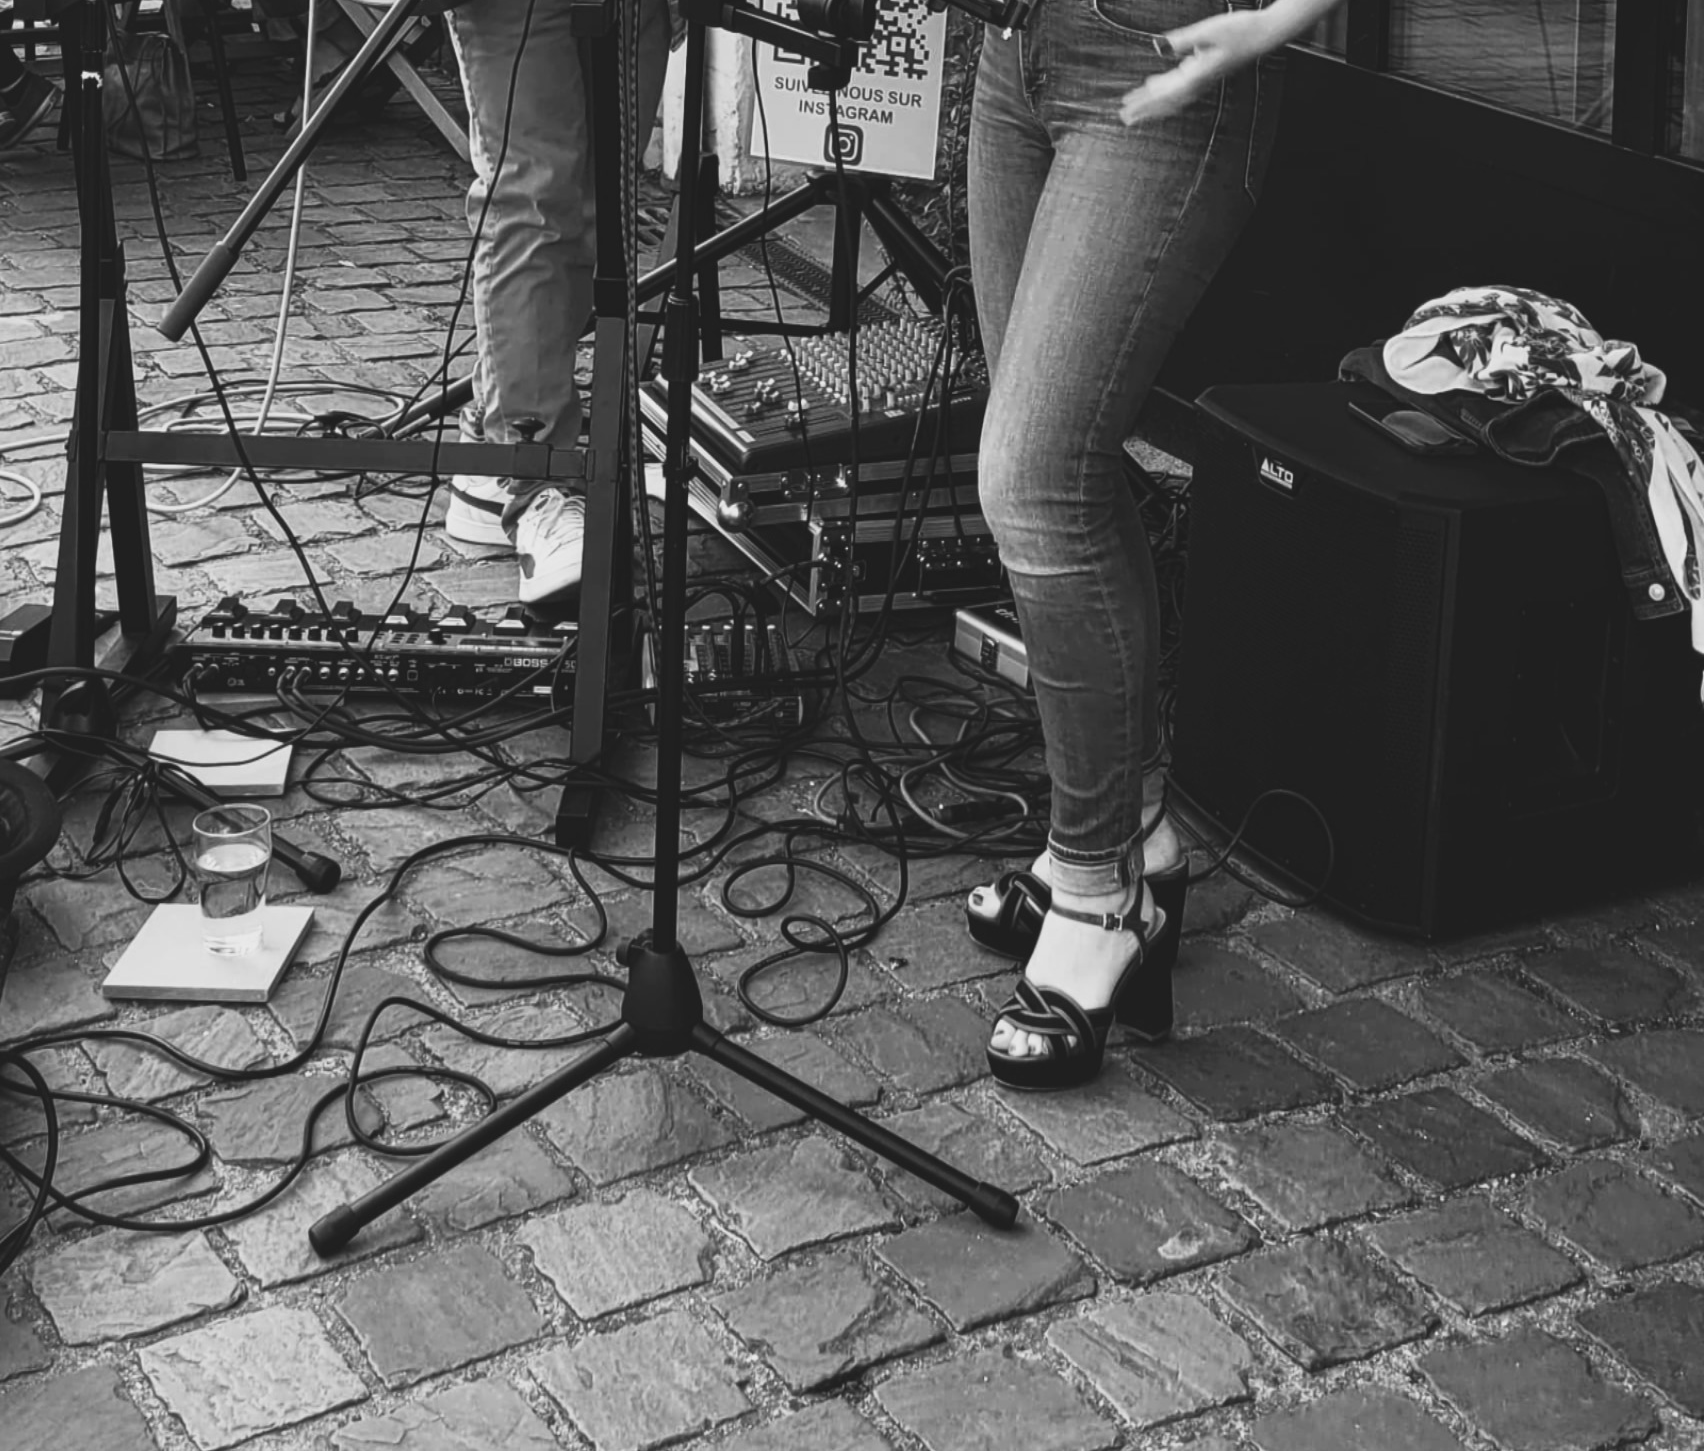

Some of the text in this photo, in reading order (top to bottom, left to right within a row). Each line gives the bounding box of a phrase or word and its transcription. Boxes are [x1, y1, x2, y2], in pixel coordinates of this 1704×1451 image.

[774, 76, 830, 96] SUIV
[888, 90, 923, 108] SUR
[799, 99, 894, 124] INSAGRAM
[1260, 457, 1294, 485] ALTO
